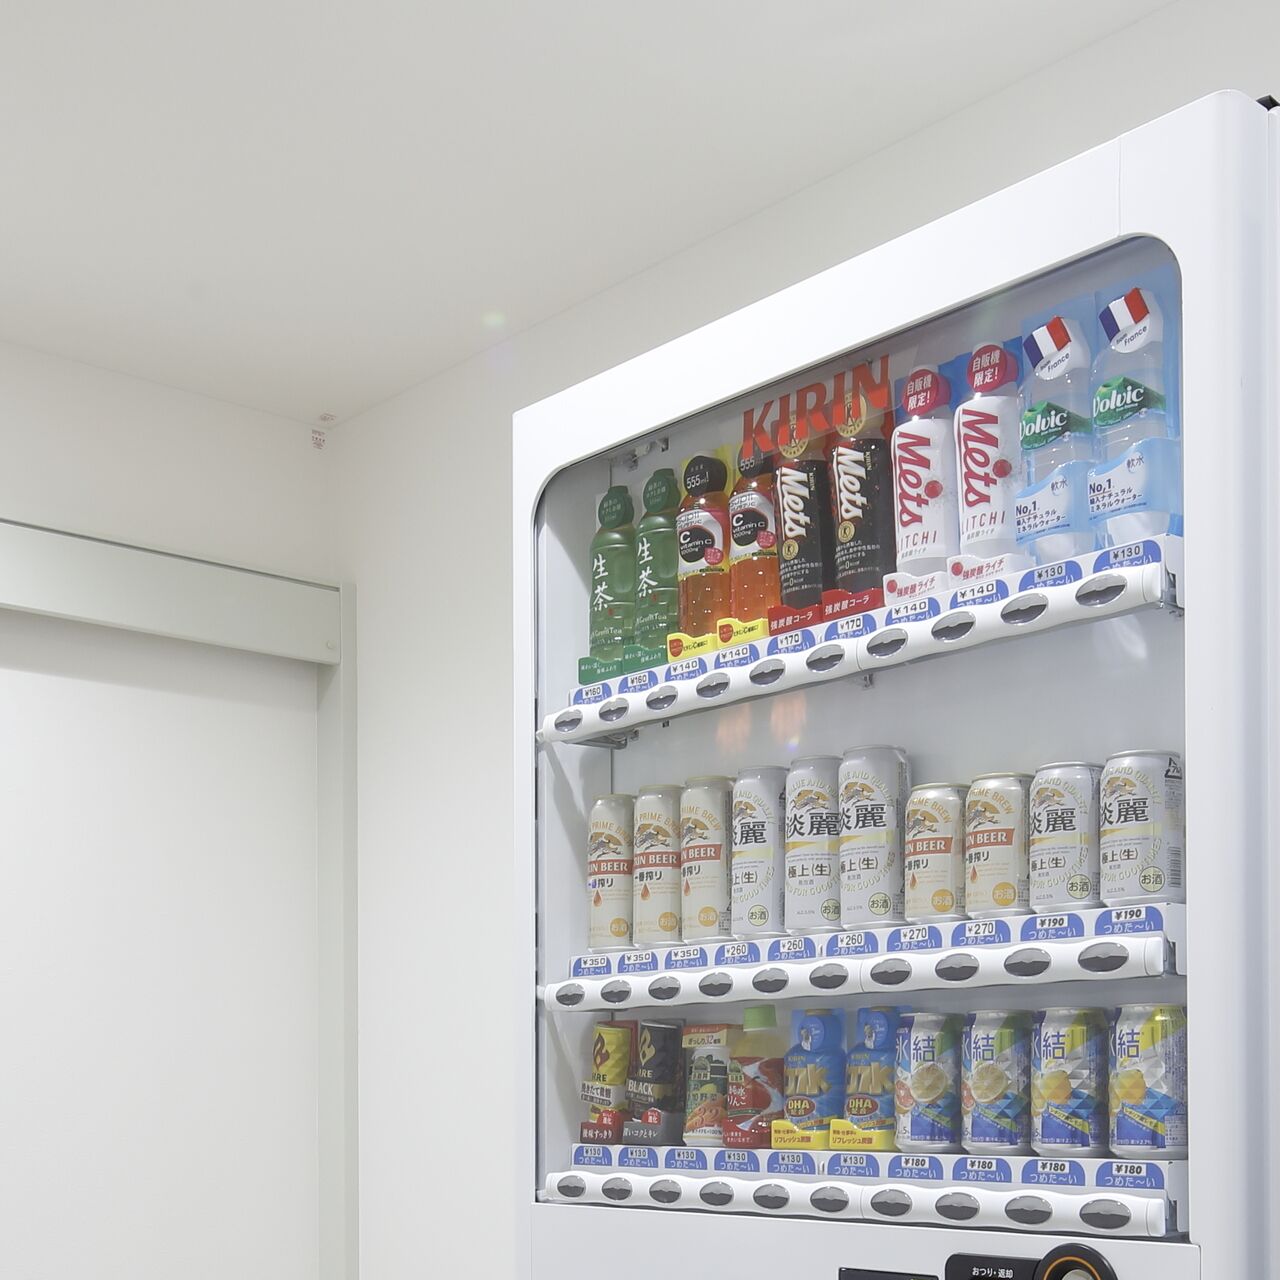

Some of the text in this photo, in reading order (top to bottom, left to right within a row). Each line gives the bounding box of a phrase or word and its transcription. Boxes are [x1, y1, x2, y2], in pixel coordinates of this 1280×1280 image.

[1124, 325, 1147, 346] France
[973, 350, 1000, 371] 自販機
[742, 355, 891, 459] KIRIN
[1093, 387, 1144, 417] Volvic
[1020, 410, 1067, 441] Volvic
[838, 446, 868, 519] Mets
[897, 432, 931, 527] Mets
[781, 466, 812, 537] Mets
[637, 538, 658, 598] 生茶
[592, 553, 614, 612] 生茶
[825, 595, 870, 615] 強炭酸コーラ
[770, 610, 813, 630] 強炭酸コーラ
[639, 813, 662, 823] PRIME
[976, 832, 1007, 843] BEER
[649, 855, 677, 864] BEER
[601, 863, 628, 871] BEER
[1141, 874, 1163, 885] お酒
[750, 911, 767, 920] お酒
[1115, 909, 1141, 920] ¥190
[1039, 918, 1064, 927] ¥190
[903, 928, 926, 940] ¥270
[968, 923, 993, 934] ¥270
[840, 934, 862, 945] ¥260
[583, 957, 605, 965] ¥350
[627, 953, 650, 961] ¥350
[788, 1100, 809, 1109] DHA
[849, 1100, 872, 1109] DHA
[970, 1160, 993, 1169] ¥180
[1115, 1165, 1142, 1174] ¥180
